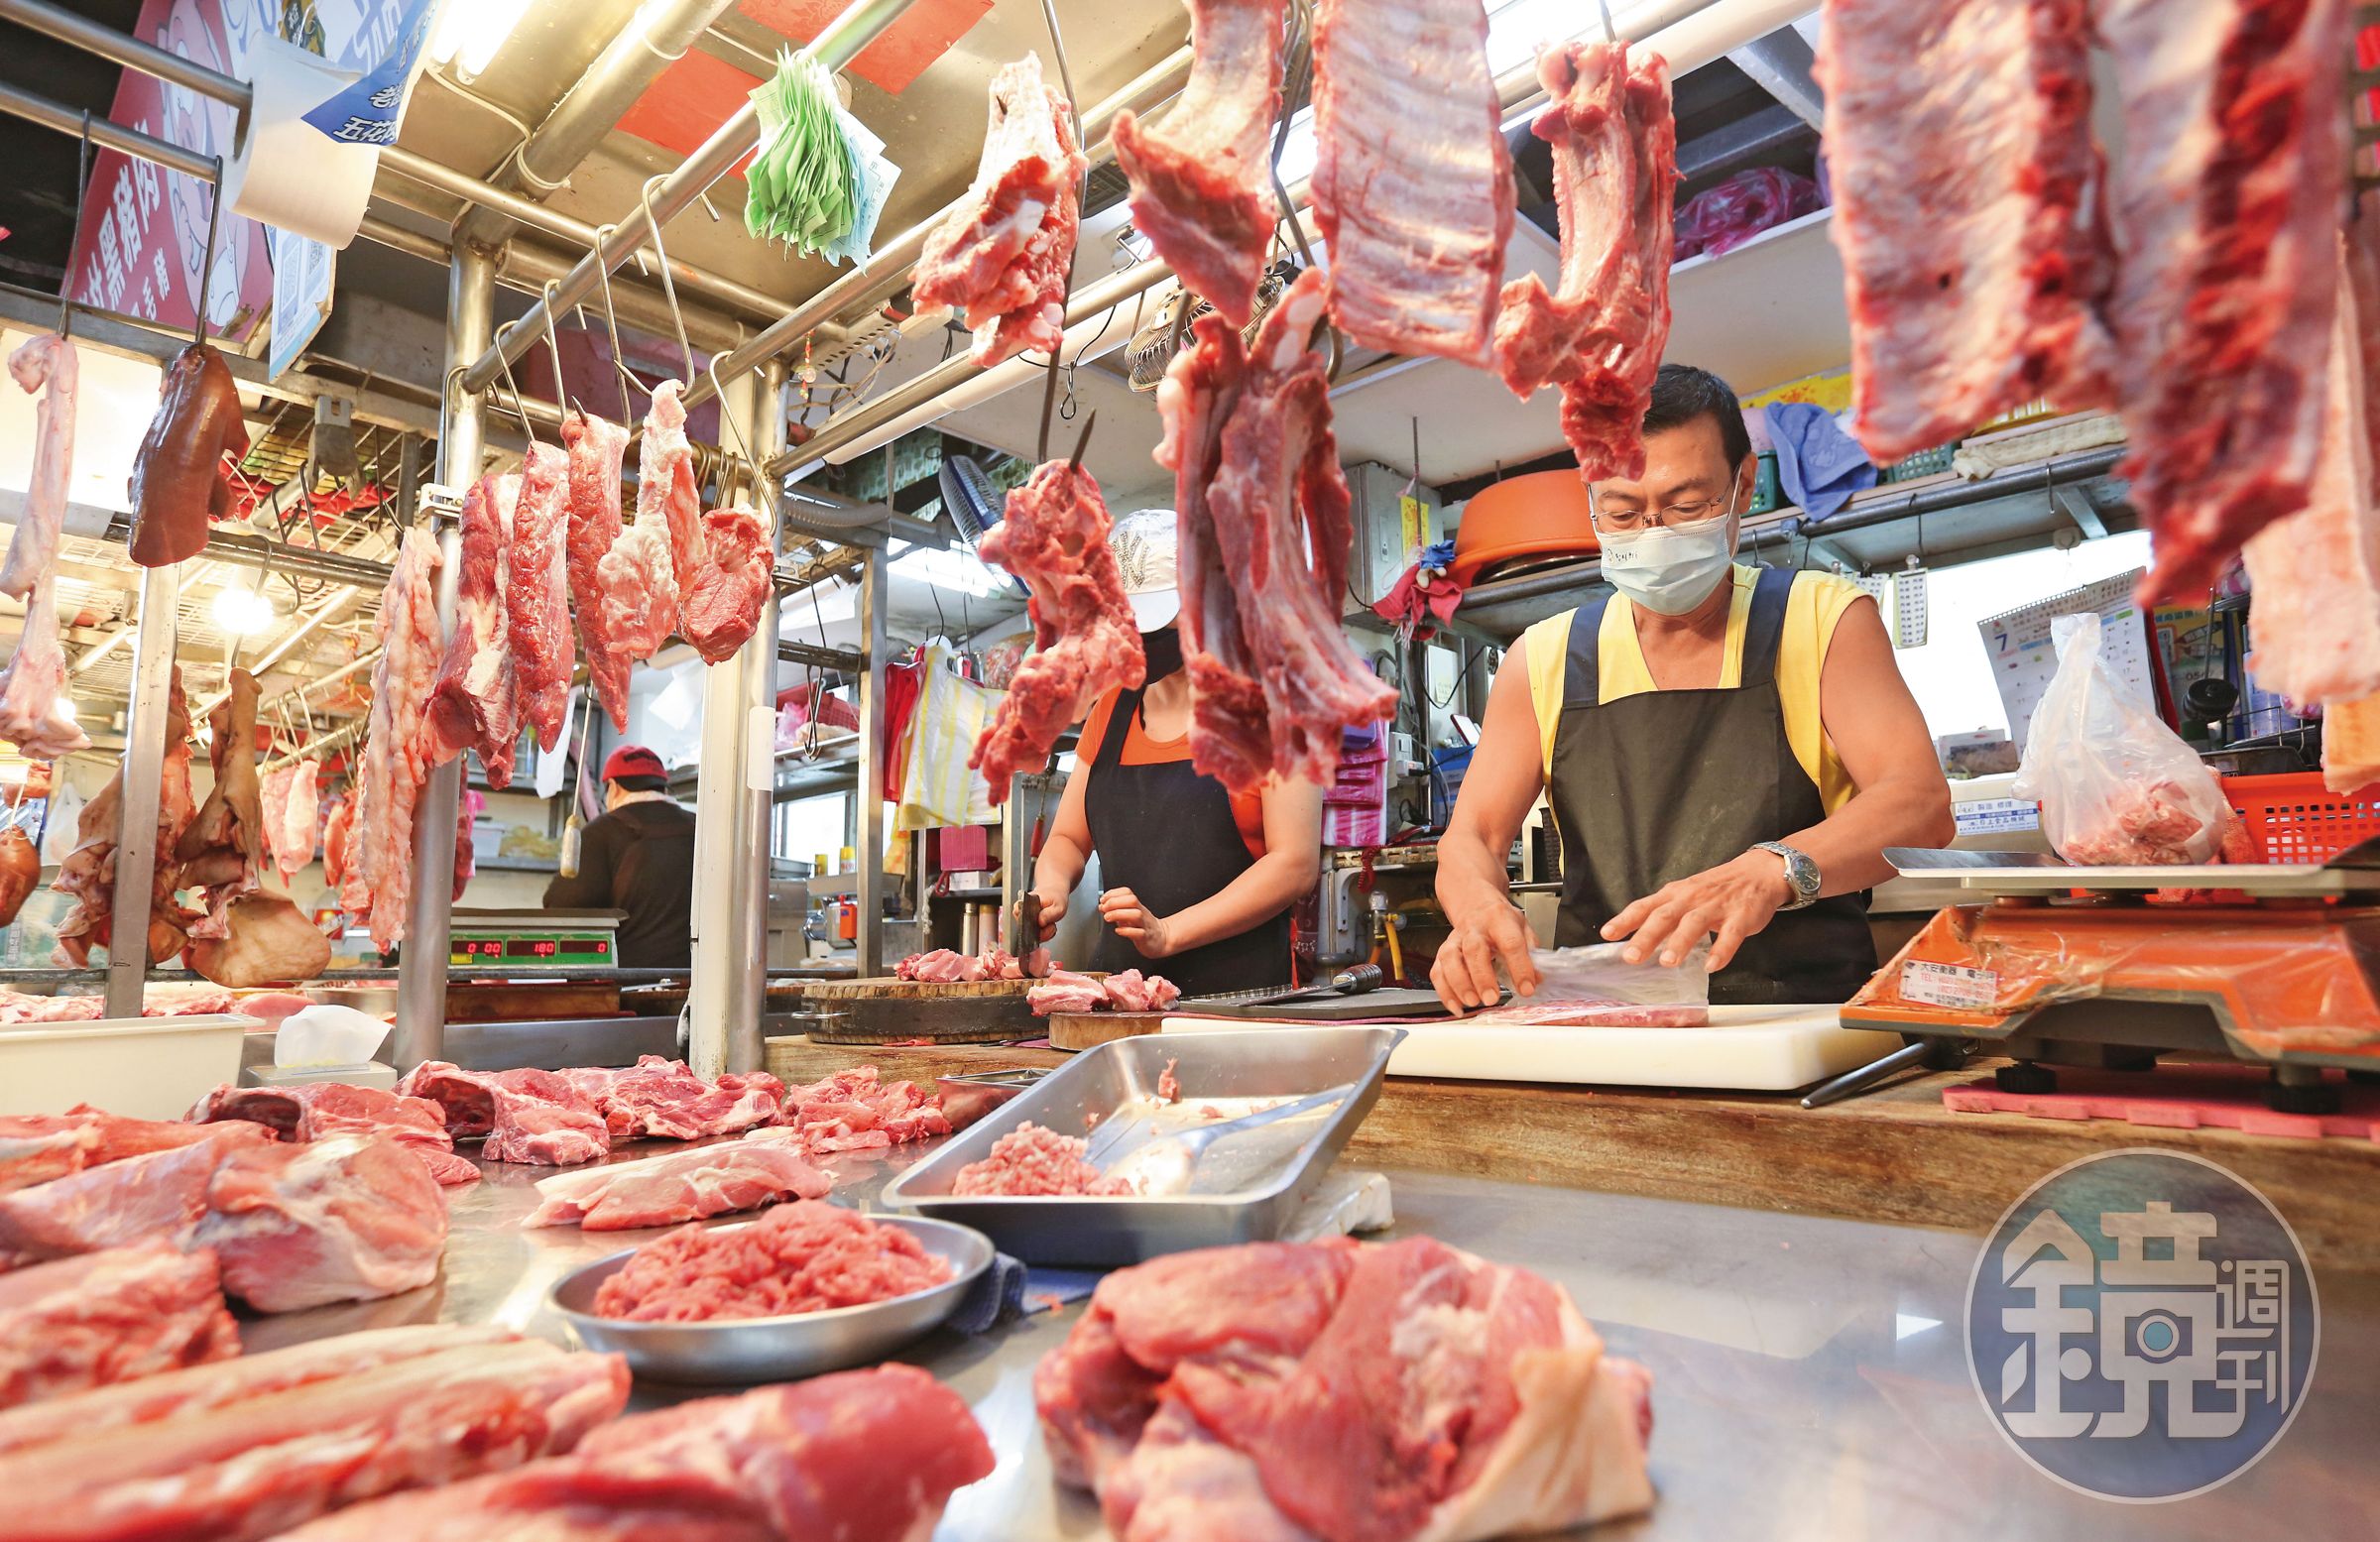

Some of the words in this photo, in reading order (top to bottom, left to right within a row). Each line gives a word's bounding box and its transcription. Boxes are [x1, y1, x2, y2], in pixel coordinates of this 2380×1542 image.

[1112, 531, 1149, 588] NY
[1995, 633, 2008, 652] 7
[534, 943, 554, 953] 180
[597, 943, 606, 953] 0
